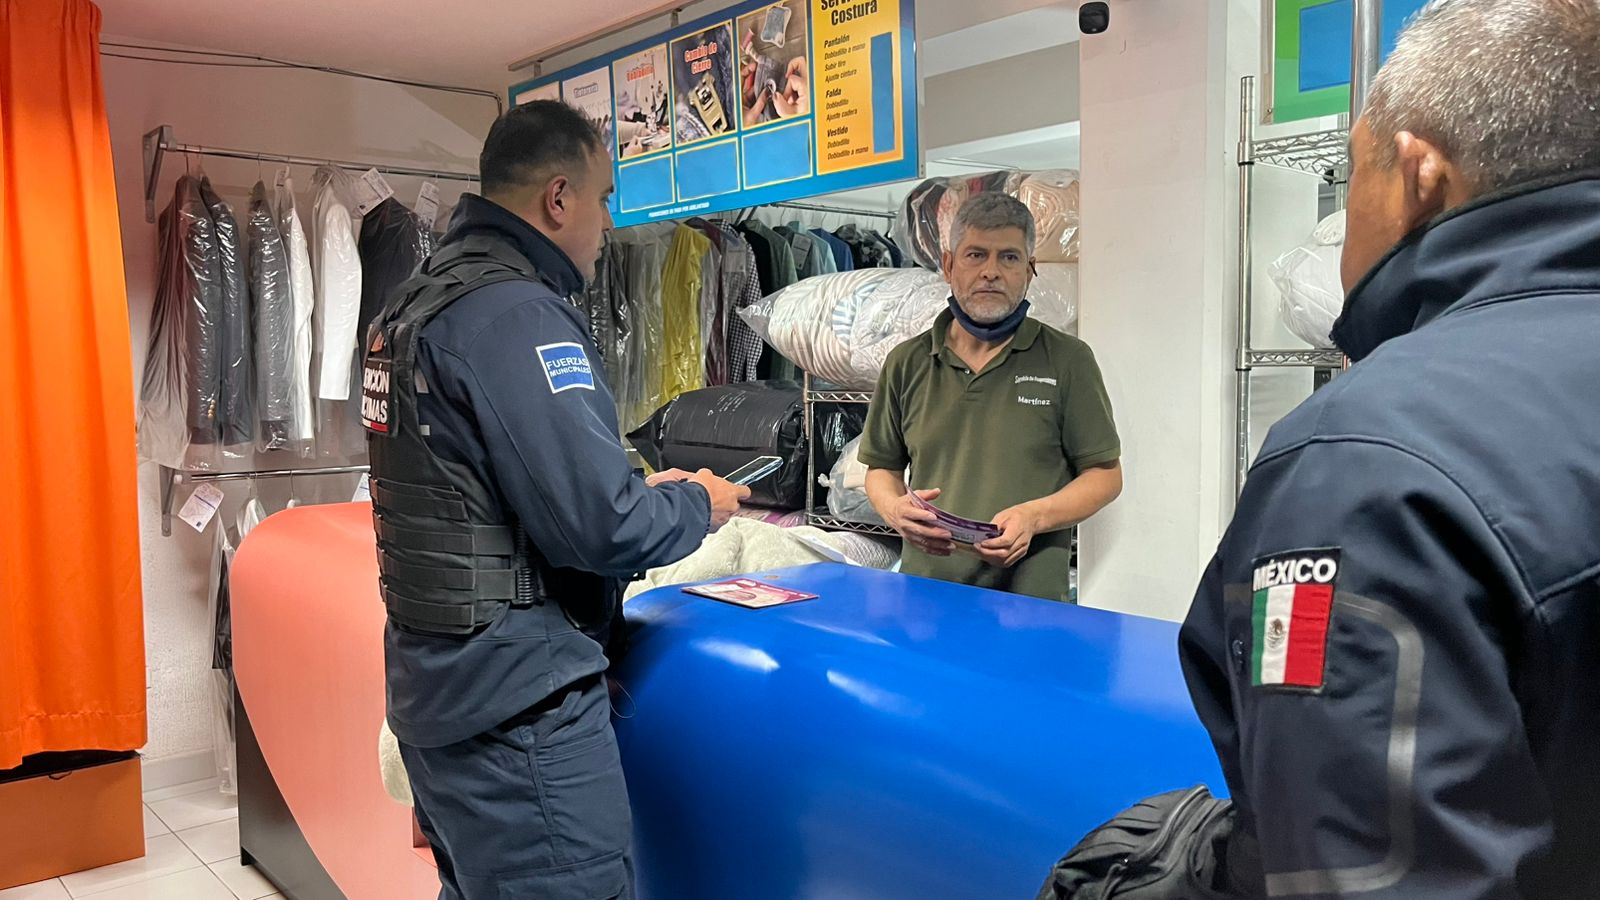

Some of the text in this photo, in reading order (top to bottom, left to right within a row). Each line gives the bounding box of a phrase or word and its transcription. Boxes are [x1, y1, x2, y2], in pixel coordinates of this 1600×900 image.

[831, 0, 878, 26] Costura
[824, 34, 850, 48] Pantalón
[824, 47, 847, 60] Dobladillo
[826, 88, 842, 98] Falda
[826, 99, 849, 110] Dobladillo
[827, 126, 848, 137] Vestido
[827, 138, 850, 149] Dobladillo
[828, 149, 850, 160] Dobladillo
[545, 357, 589, 370] FUERZAS
[1017, 395, 1051, 406] Martínez
[1252, 558, 1337, 592] MÉXICO
